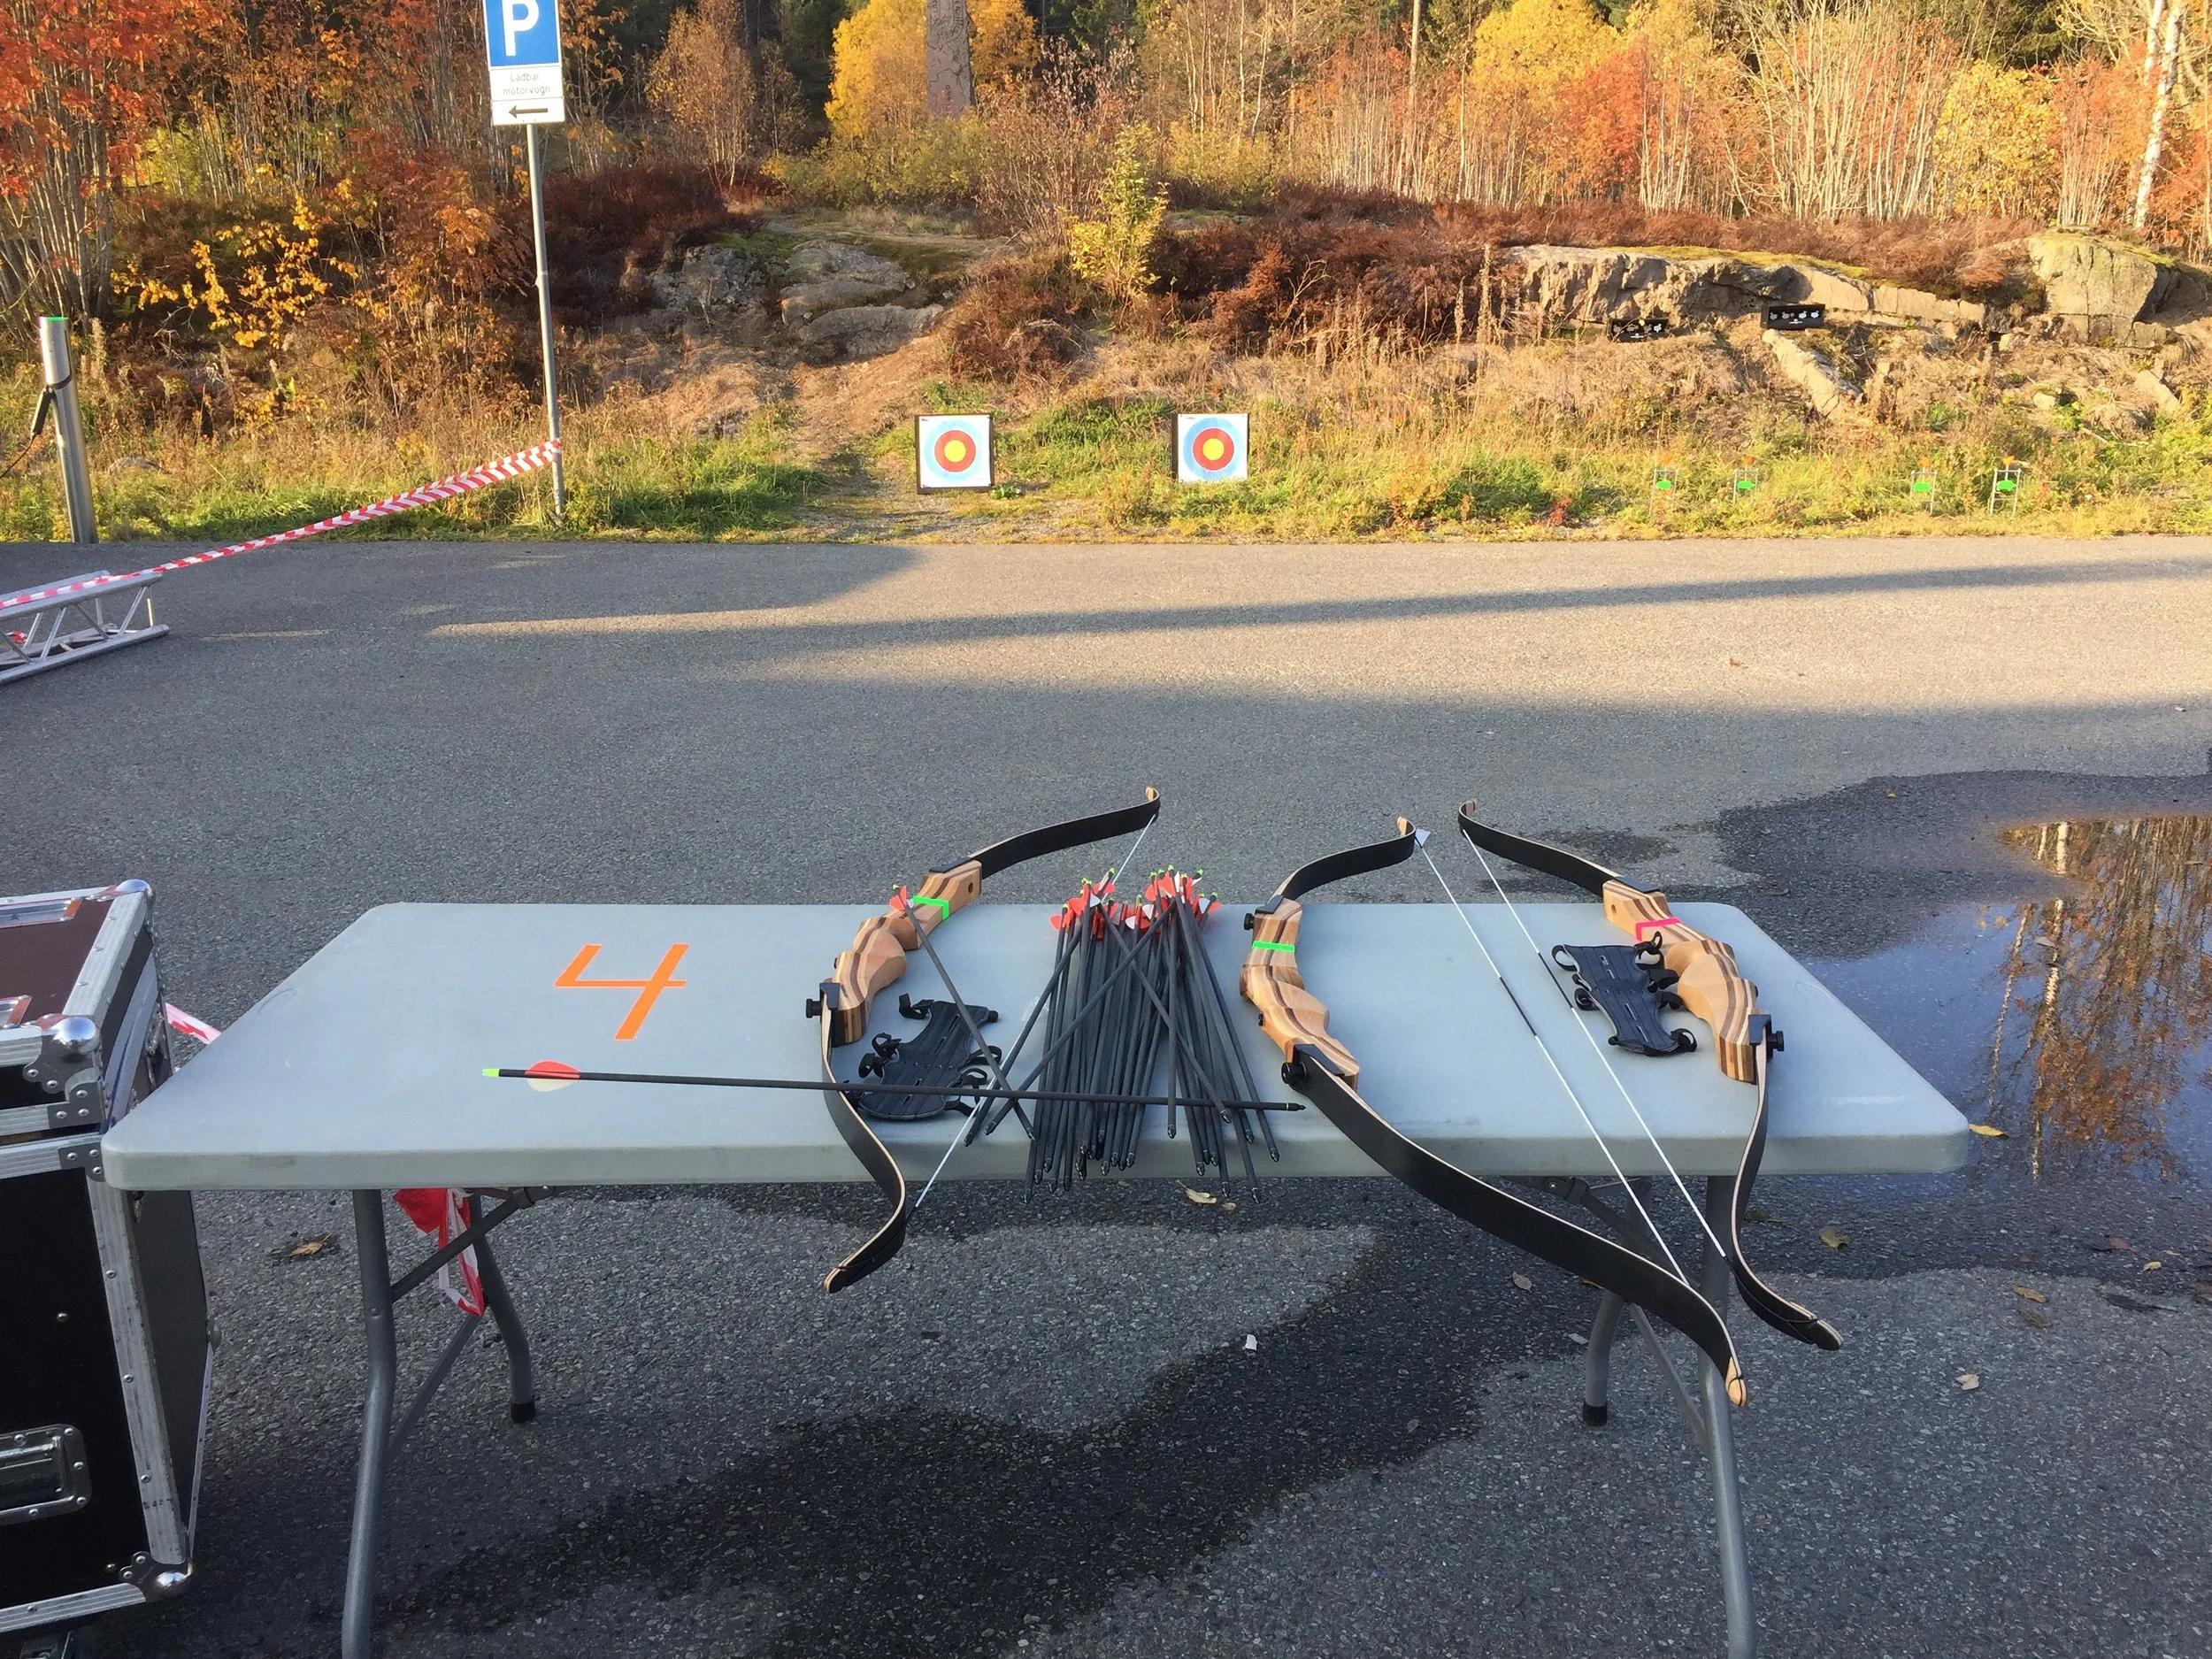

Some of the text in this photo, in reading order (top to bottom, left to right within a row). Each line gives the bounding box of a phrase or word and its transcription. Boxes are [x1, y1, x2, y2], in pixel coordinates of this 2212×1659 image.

[502, 0, 540, 57] P
[503, 86, 551, 96] motorvogn
[510, 73, 540, 82] Ladbar
[554, 943, 690, 1041] 4
